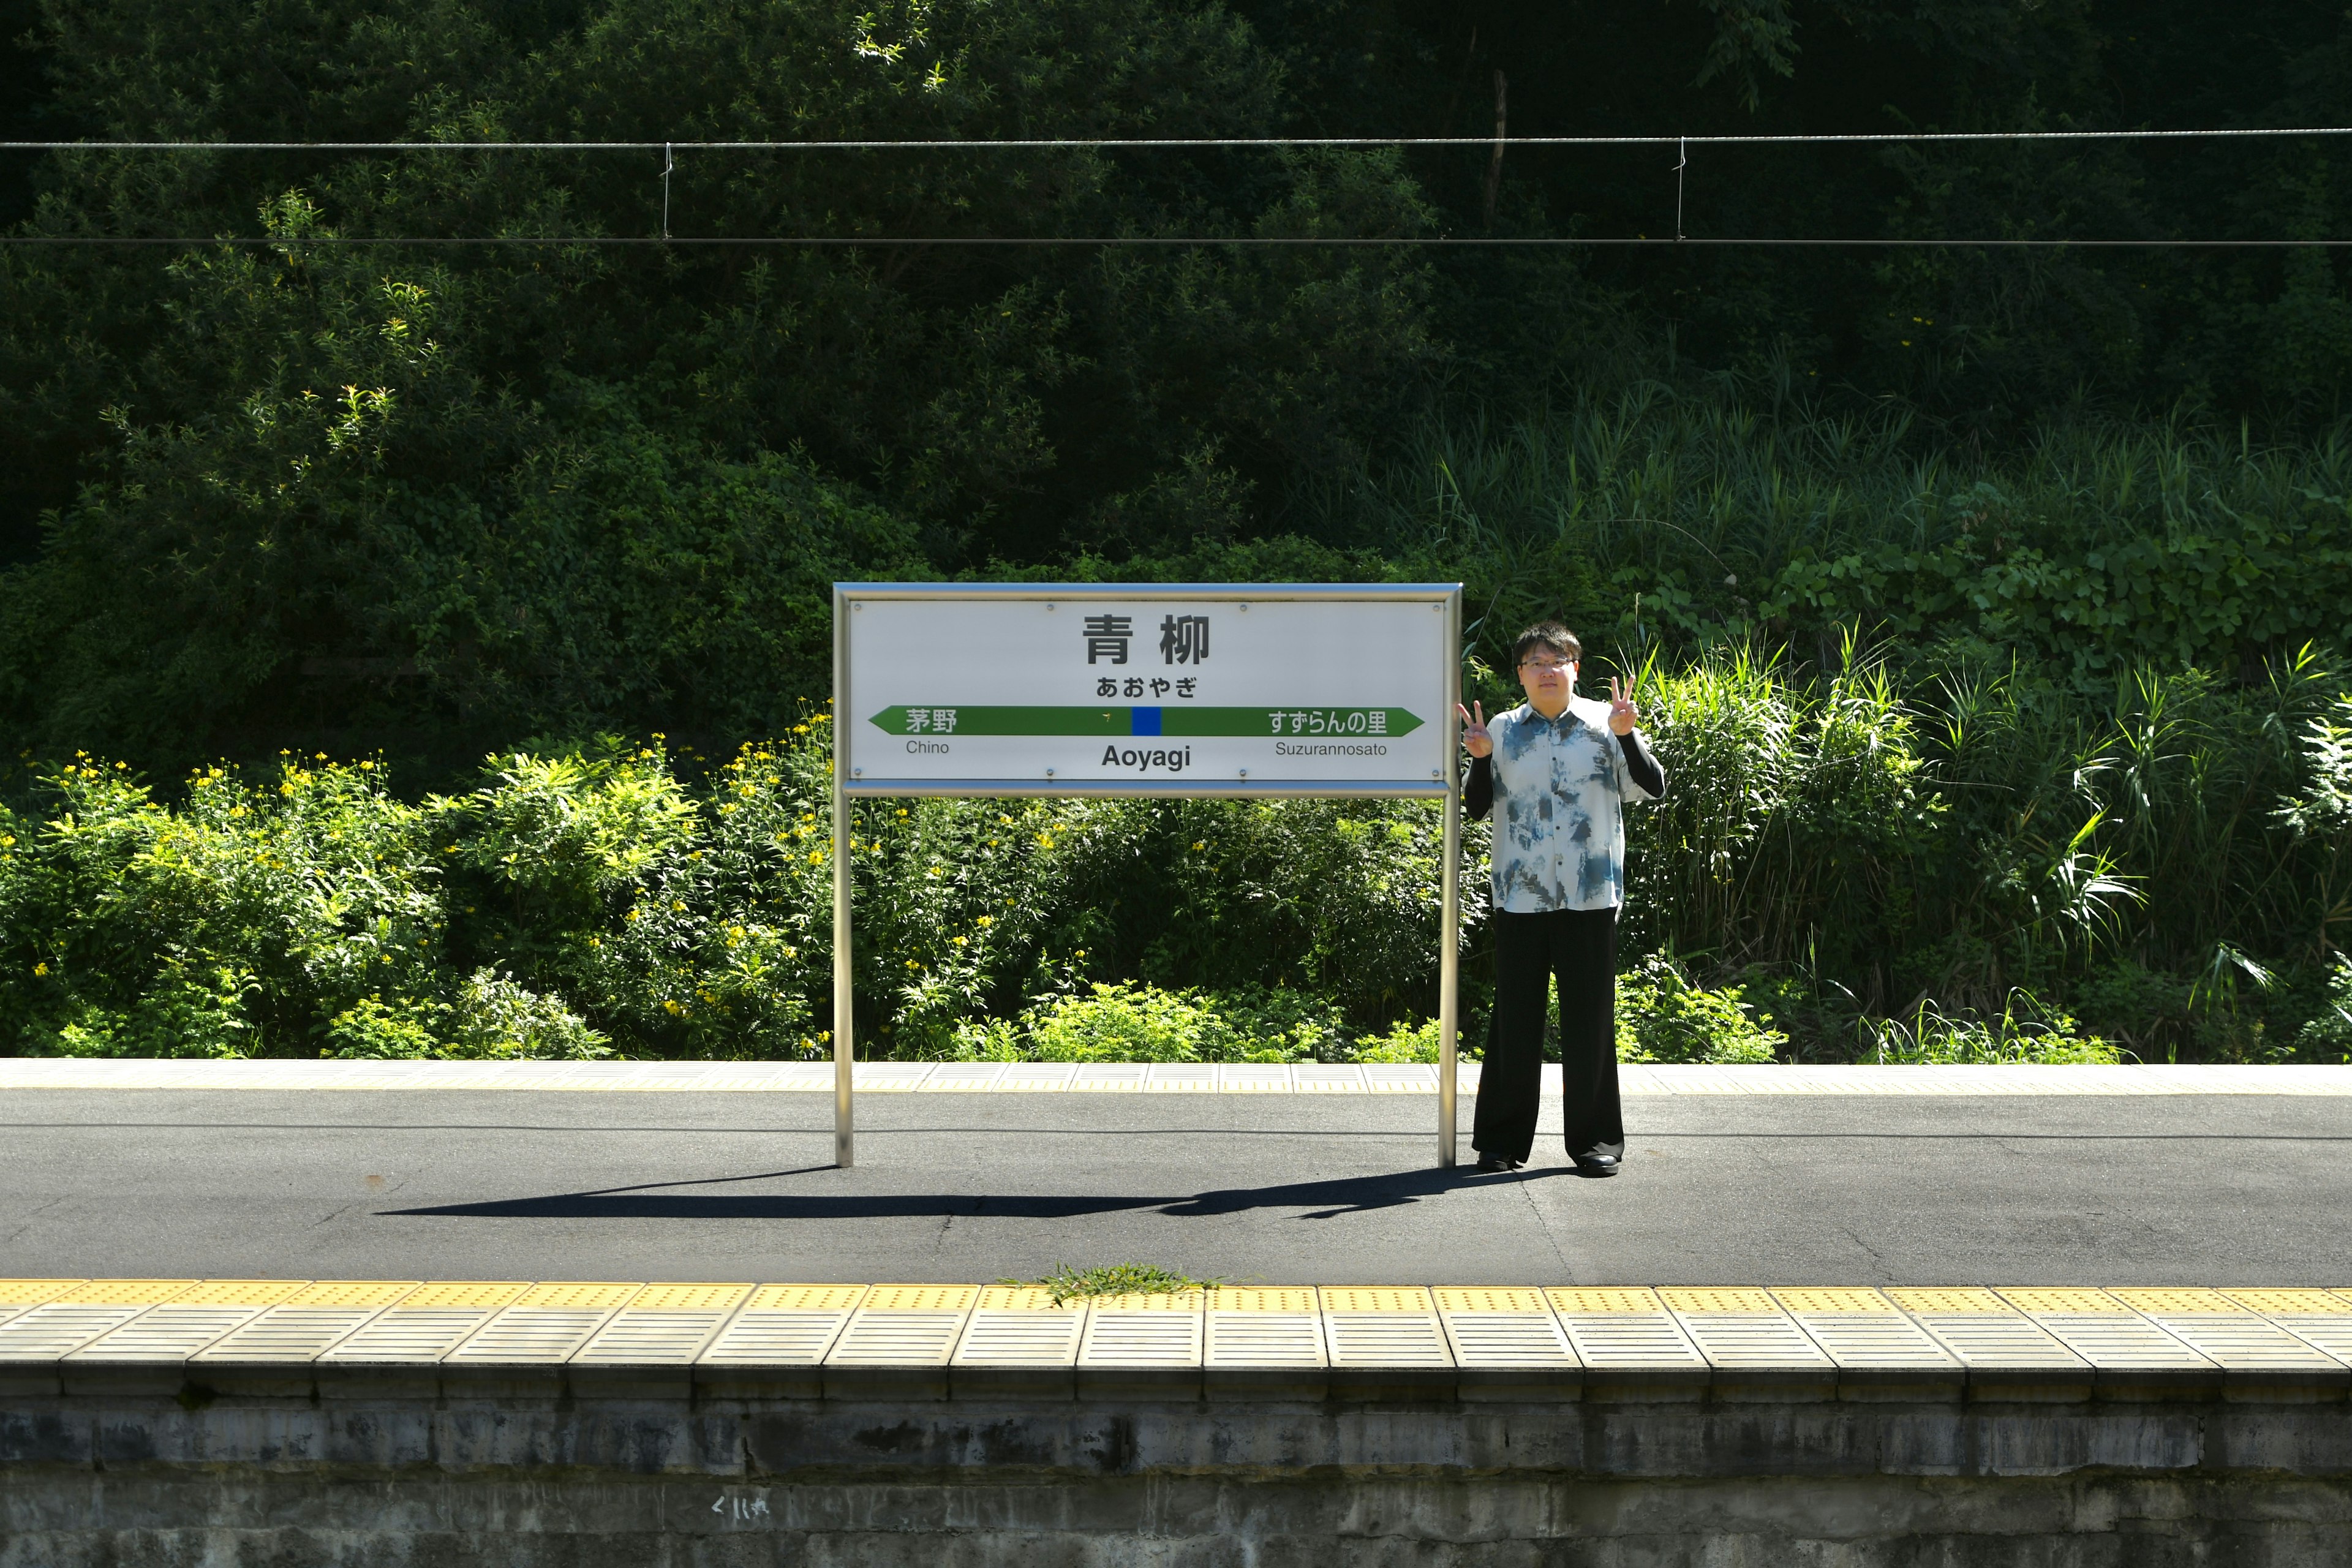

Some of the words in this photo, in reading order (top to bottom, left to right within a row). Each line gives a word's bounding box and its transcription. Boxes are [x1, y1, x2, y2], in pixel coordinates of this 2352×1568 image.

[1082, 614, 1209, 665] 青柳
[1096, 676, 1197, 698] あおやぎ
[907, 708, 957, 733] 茅野
[1268, 710, 1387, 734] すずらんの里
[906, 740, 949, 754] Chino
[1101, 745, 1190, 772] Aoyagi
[1275, 742, 1387, 756] Suzurannosato
